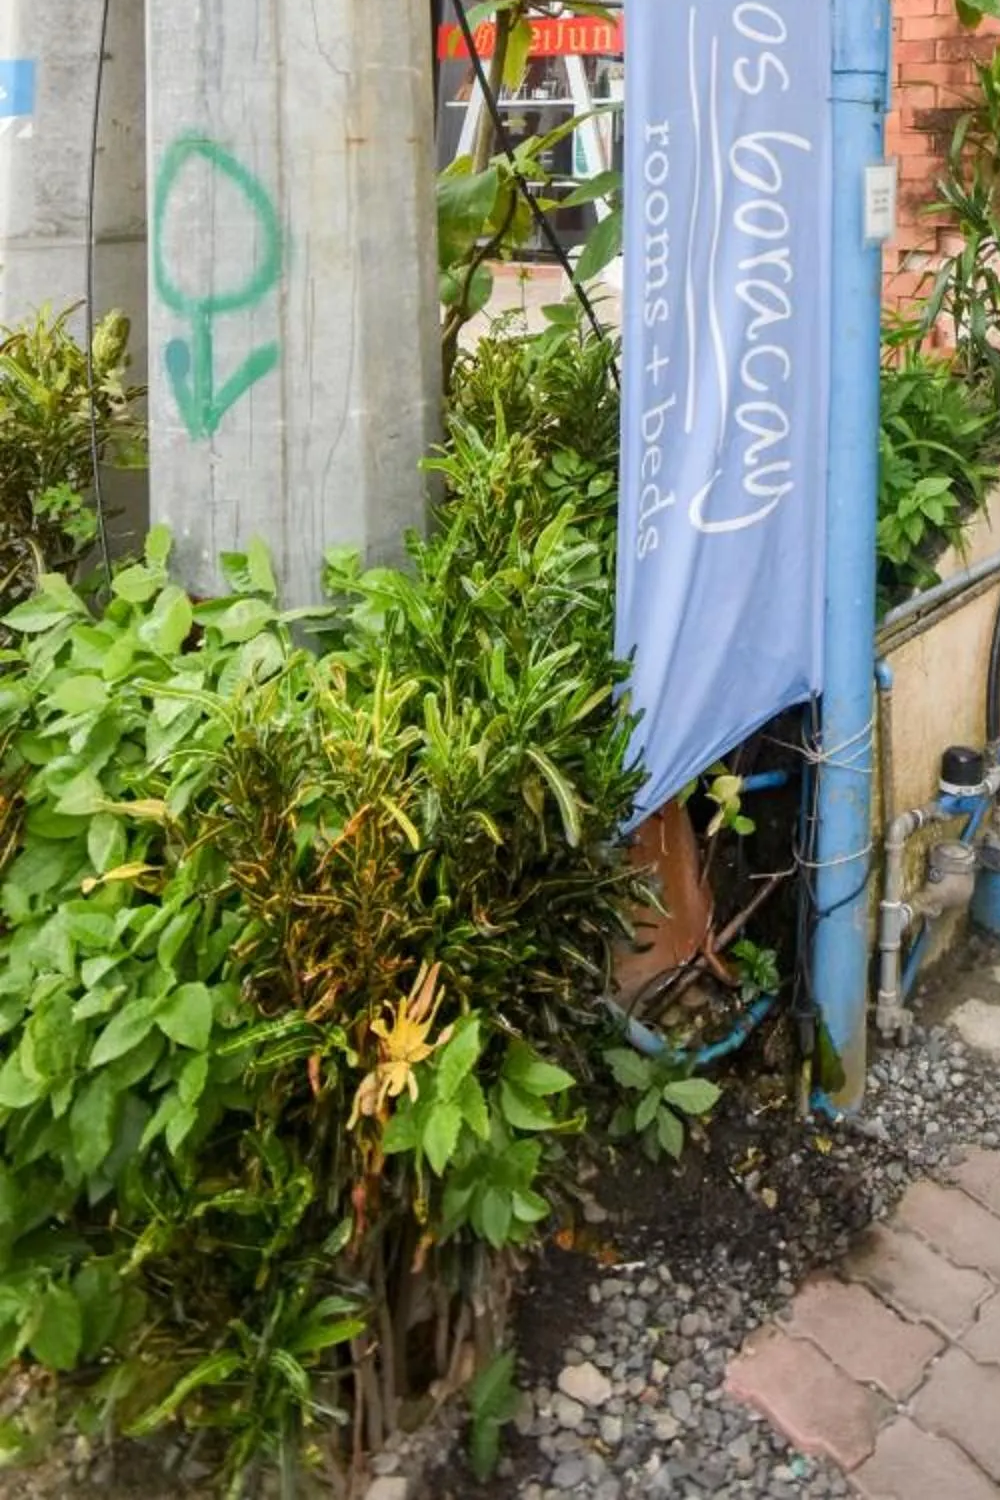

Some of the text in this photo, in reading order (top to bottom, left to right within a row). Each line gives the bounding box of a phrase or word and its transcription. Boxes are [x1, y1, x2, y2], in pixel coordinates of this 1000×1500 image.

[529, 23, 611, 51] eiJun
[644, 121, 670, 324] rooms
[688, 130, 811, 533] boracay
[637, 392, 677, 561] beds
